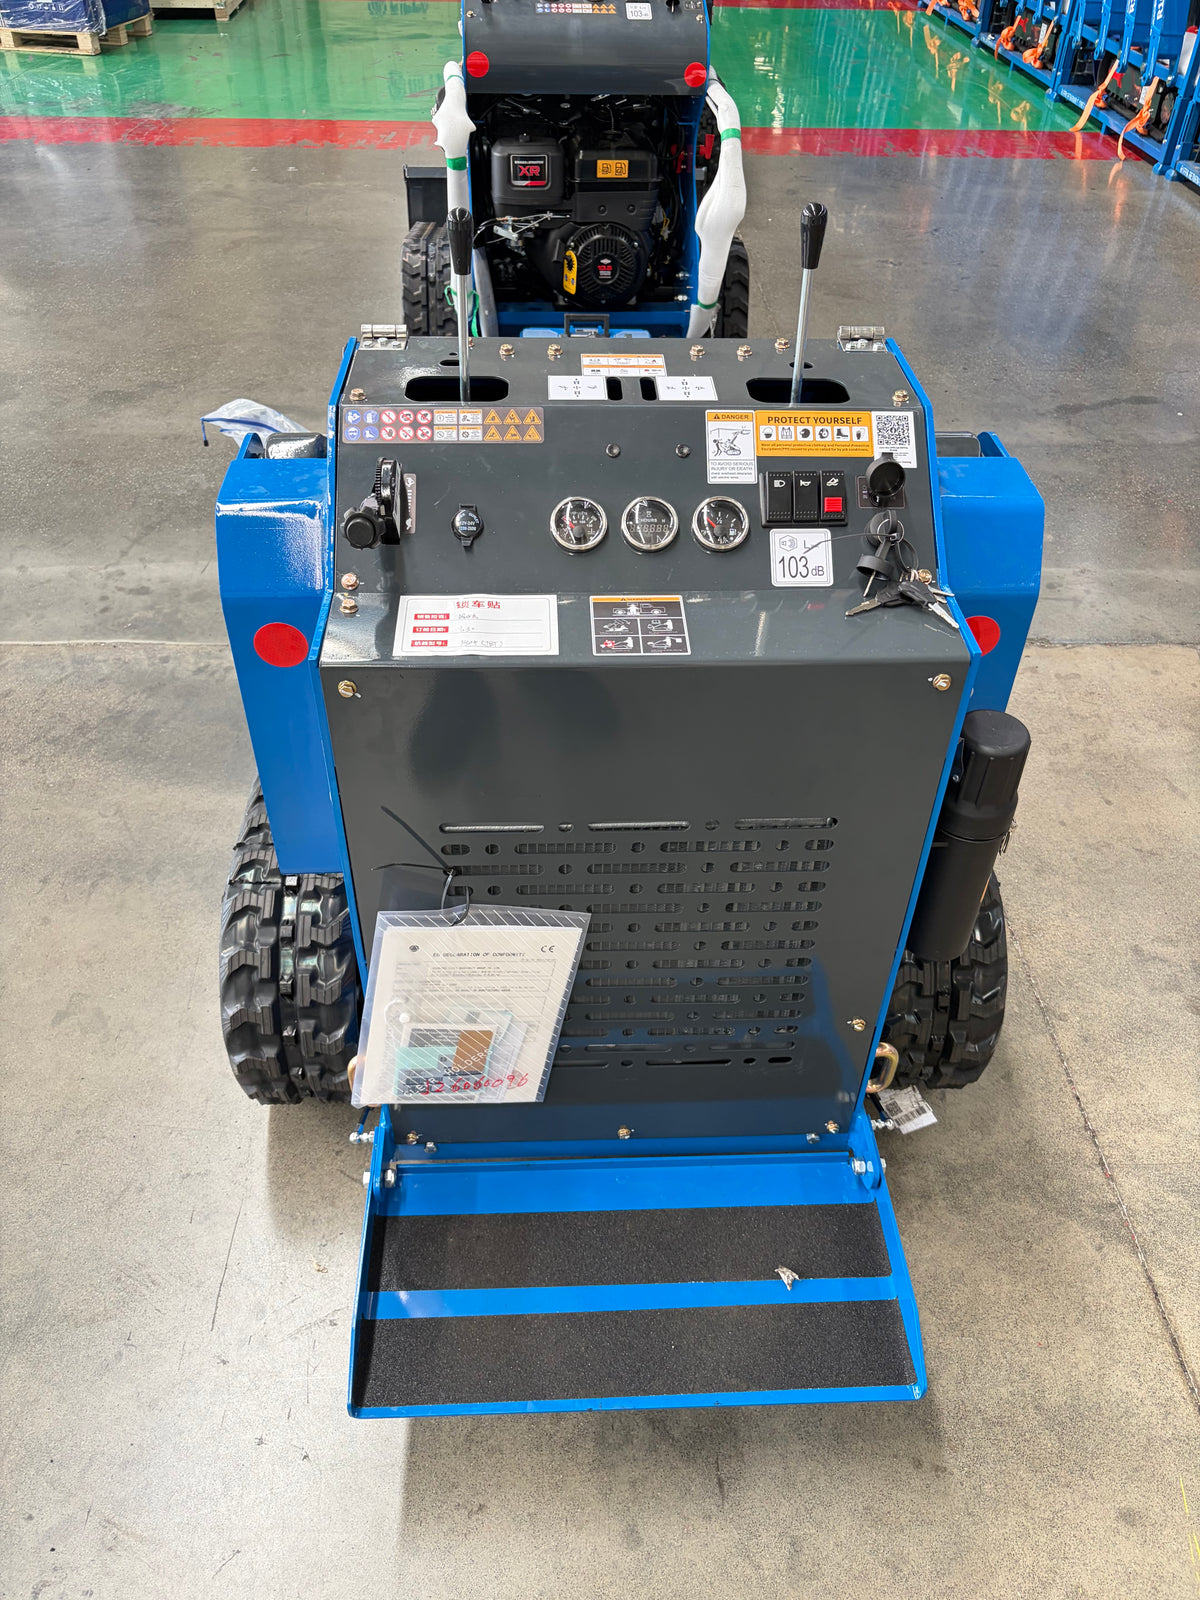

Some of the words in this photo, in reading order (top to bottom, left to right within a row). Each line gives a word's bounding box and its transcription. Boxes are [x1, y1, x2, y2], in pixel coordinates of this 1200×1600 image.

[519, 165, 541, 176] XR
[767, 416, 811, 424] PROTECT
[812, 416, 862, 425] YOURSELF
[778, 555, 810, 579] 103
[811, 565, 825, 577] dB
[456, 600, 501, 609] 锁车贴
[540, 945, 555, 953] CE
[444, 1048, 494, 1076] HOLDERS
